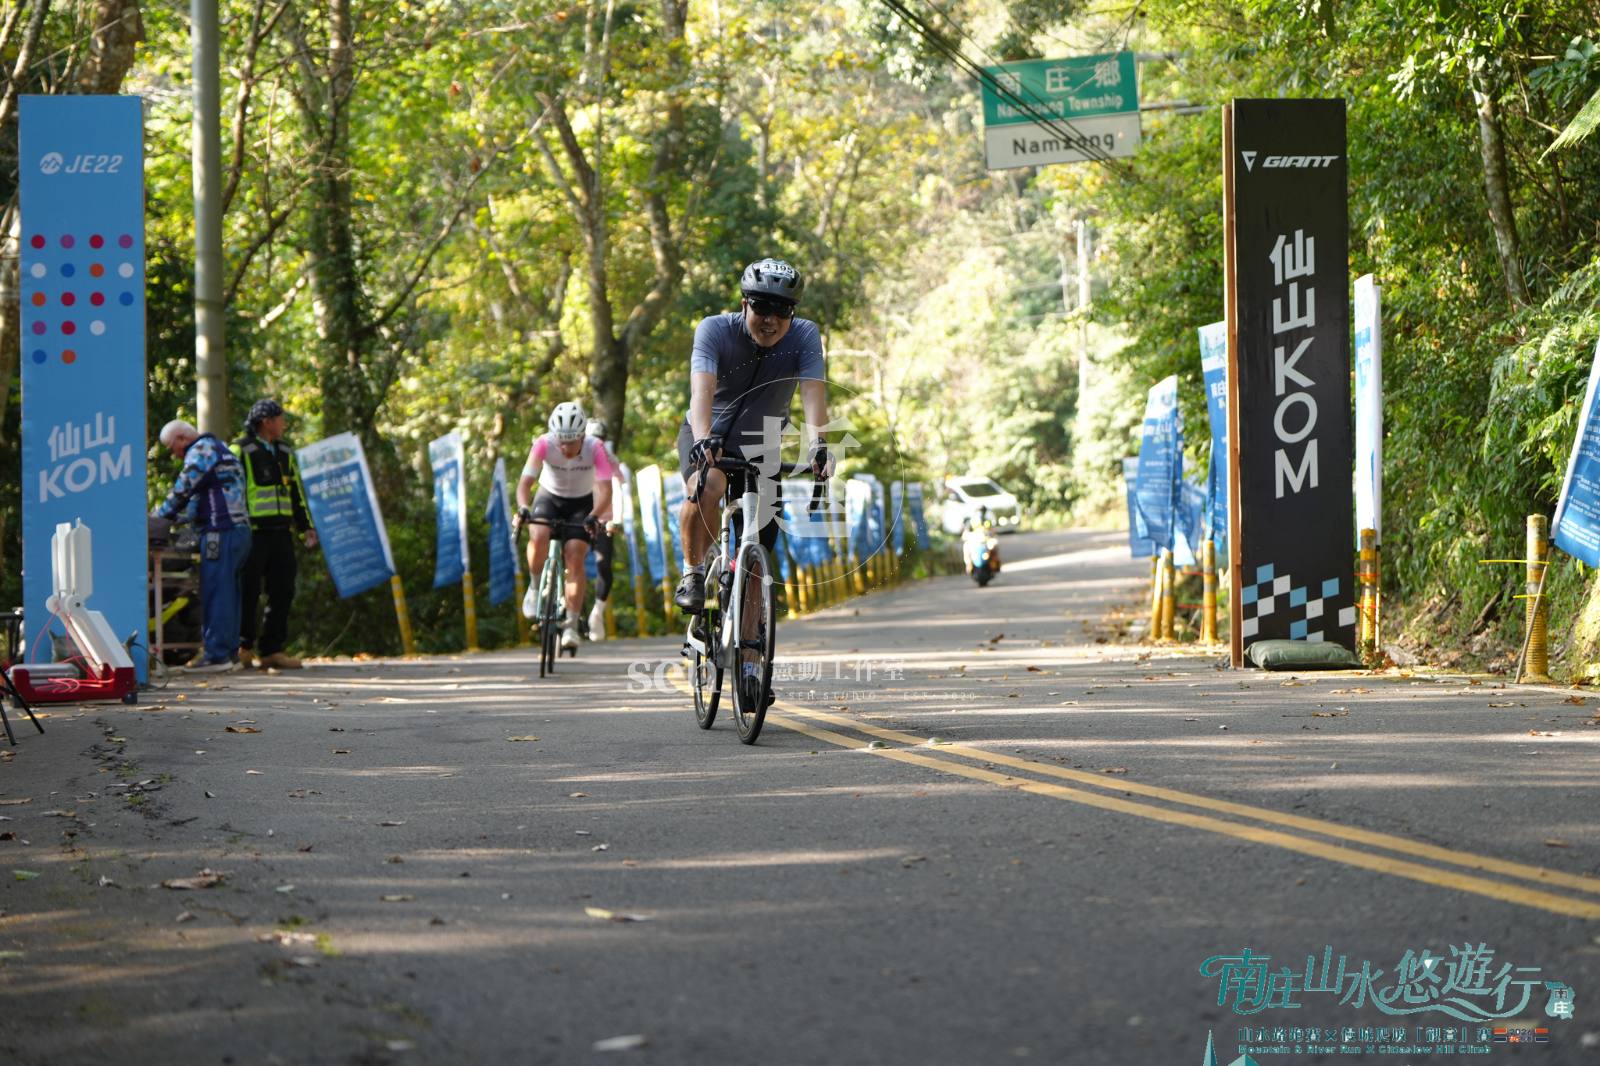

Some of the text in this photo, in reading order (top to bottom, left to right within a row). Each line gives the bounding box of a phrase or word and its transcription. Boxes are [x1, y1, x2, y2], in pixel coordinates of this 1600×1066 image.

[1068, 94, 1124, 112] Township
[64, 154, 123, 174] JE22
[1262, 155, 1340, 168] GIANT
[39, 443, 133, 504] KOM
